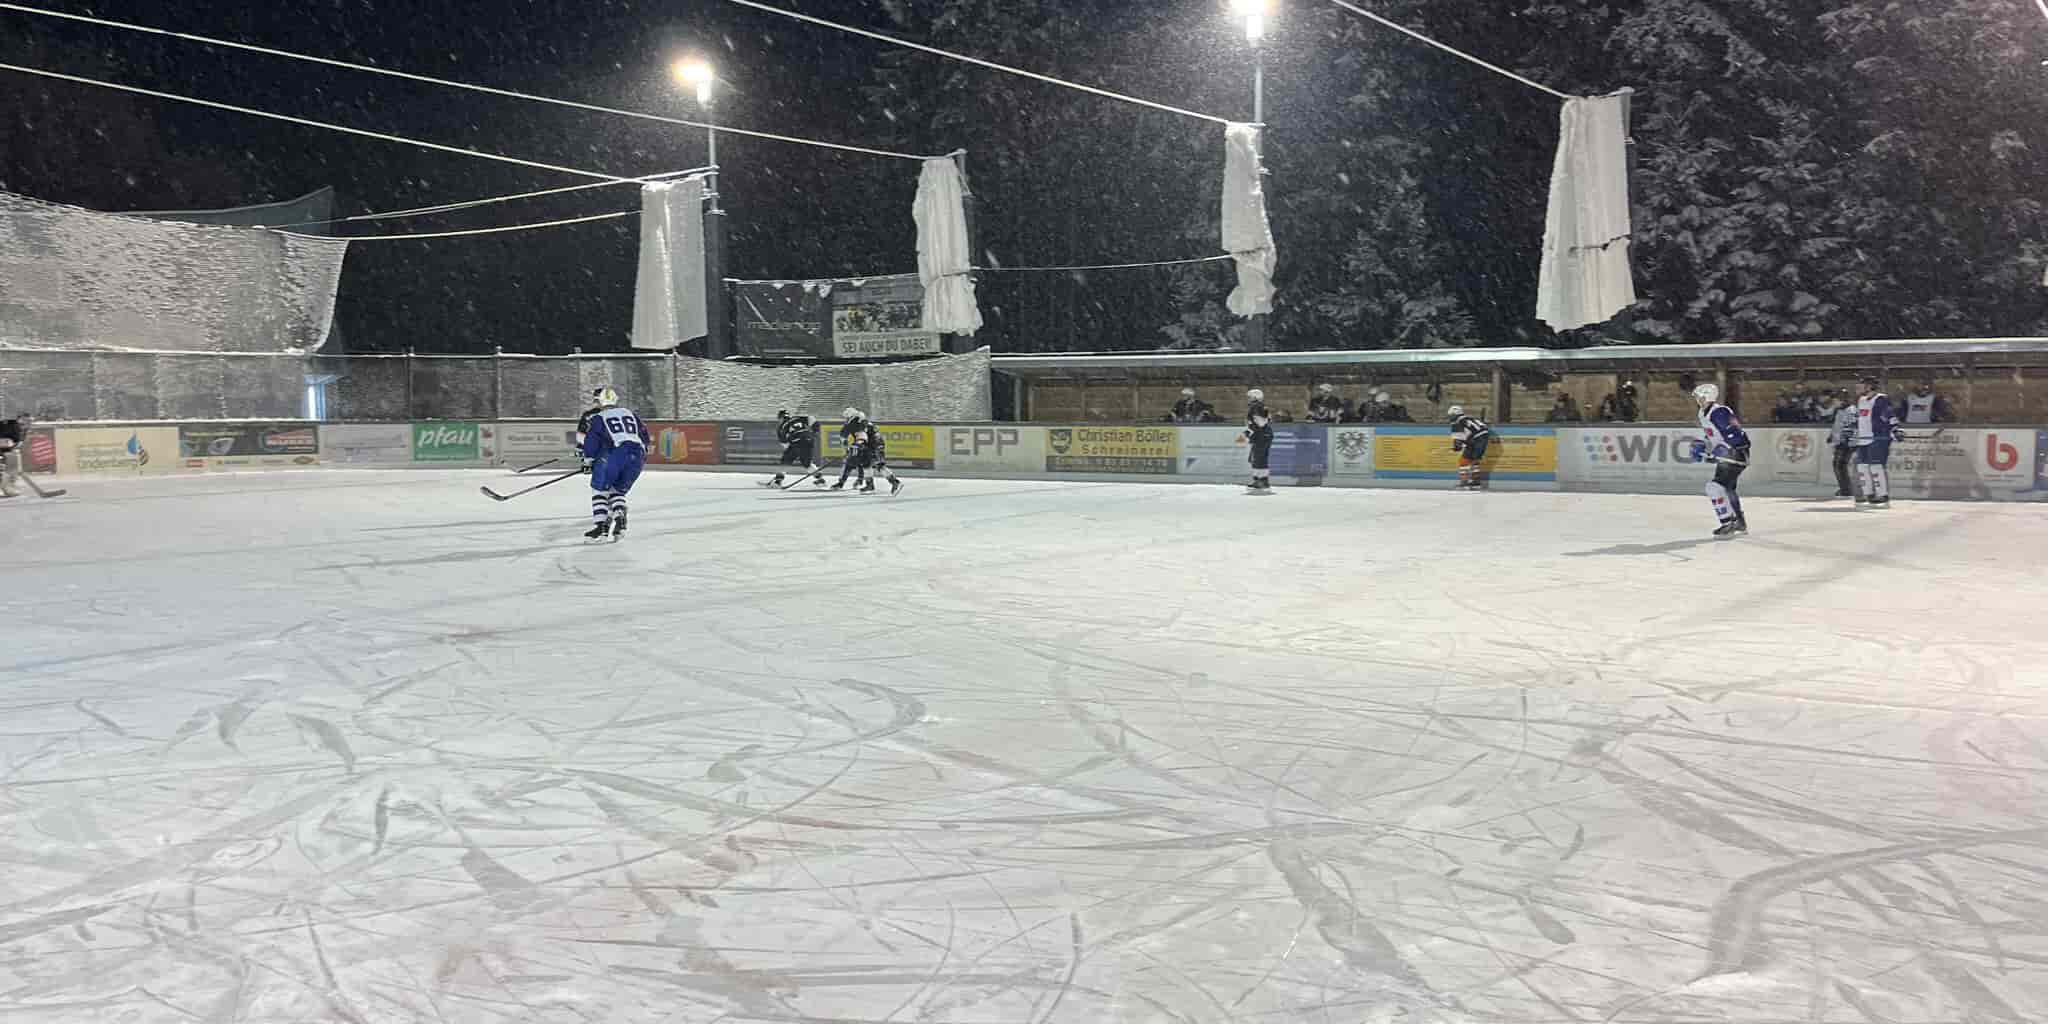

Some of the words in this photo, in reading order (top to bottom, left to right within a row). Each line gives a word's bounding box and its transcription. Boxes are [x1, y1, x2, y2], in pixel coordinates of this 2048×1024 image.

[859, 338, 884, 352] AUCH
[606, 416, 637, 434] 66
[417, 426, 474, 448] pfau
[951, 429, 1019, 456] EPP
[1078, 429, 1134, 442] Christian
[1081, 444, 1169, 456] Schreinerei
